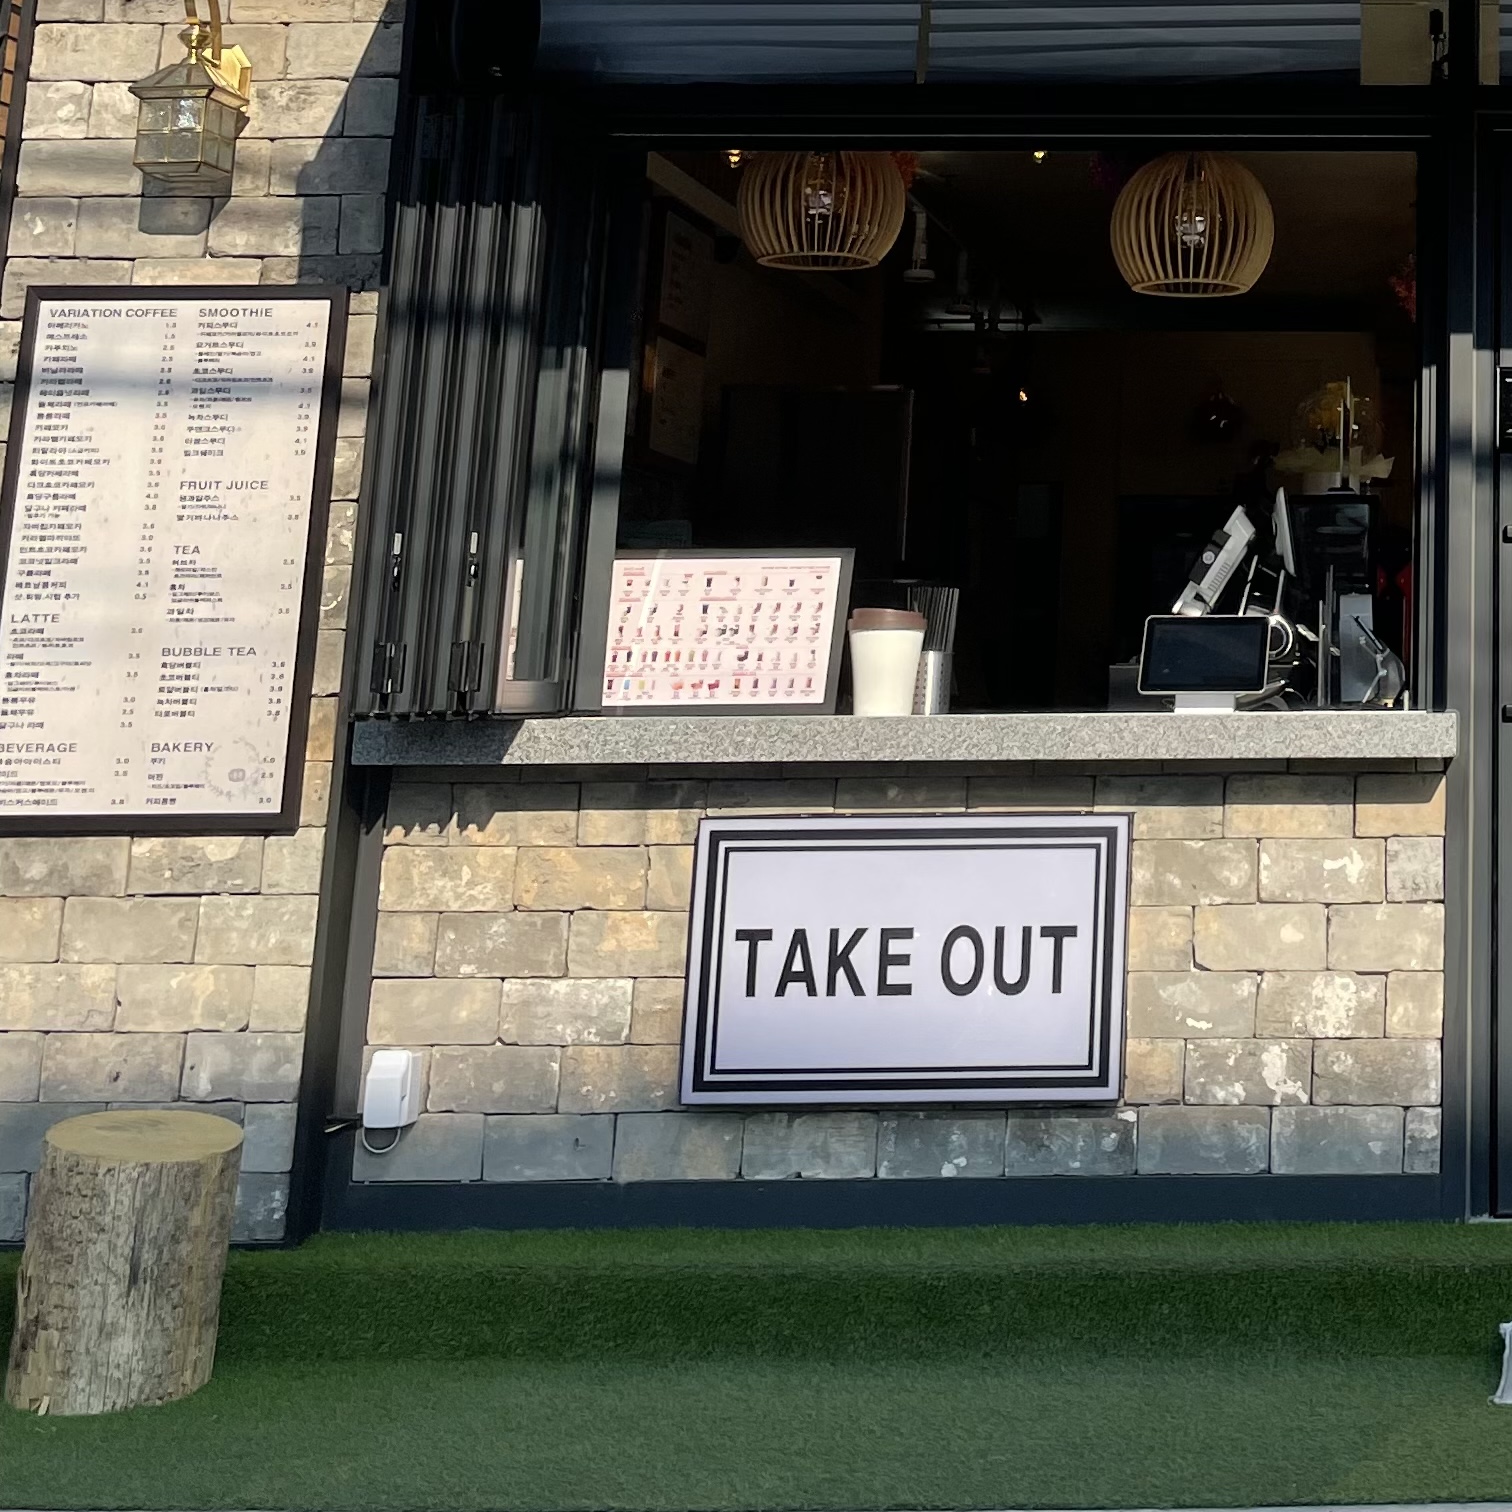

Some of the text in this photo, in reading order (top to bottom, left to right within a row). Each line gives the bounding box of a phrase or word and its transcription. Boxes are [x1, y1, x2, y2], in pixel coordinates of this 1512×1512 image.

[50, 308, 178, 318] VARIATION COFFEE
[199, 308, 273, 317] SMOOTHIE
[180, 481, 269, 490] FRUIT JUICE
[174, 545, 200, 555] TEA
[11, 614, 60, 624] LATTE
[161, 647, 256, 657] BUBBLE TEA
[151, 742, 214, 753] BAKERY
[735, 924, 1078, 998] TAKE OUT
